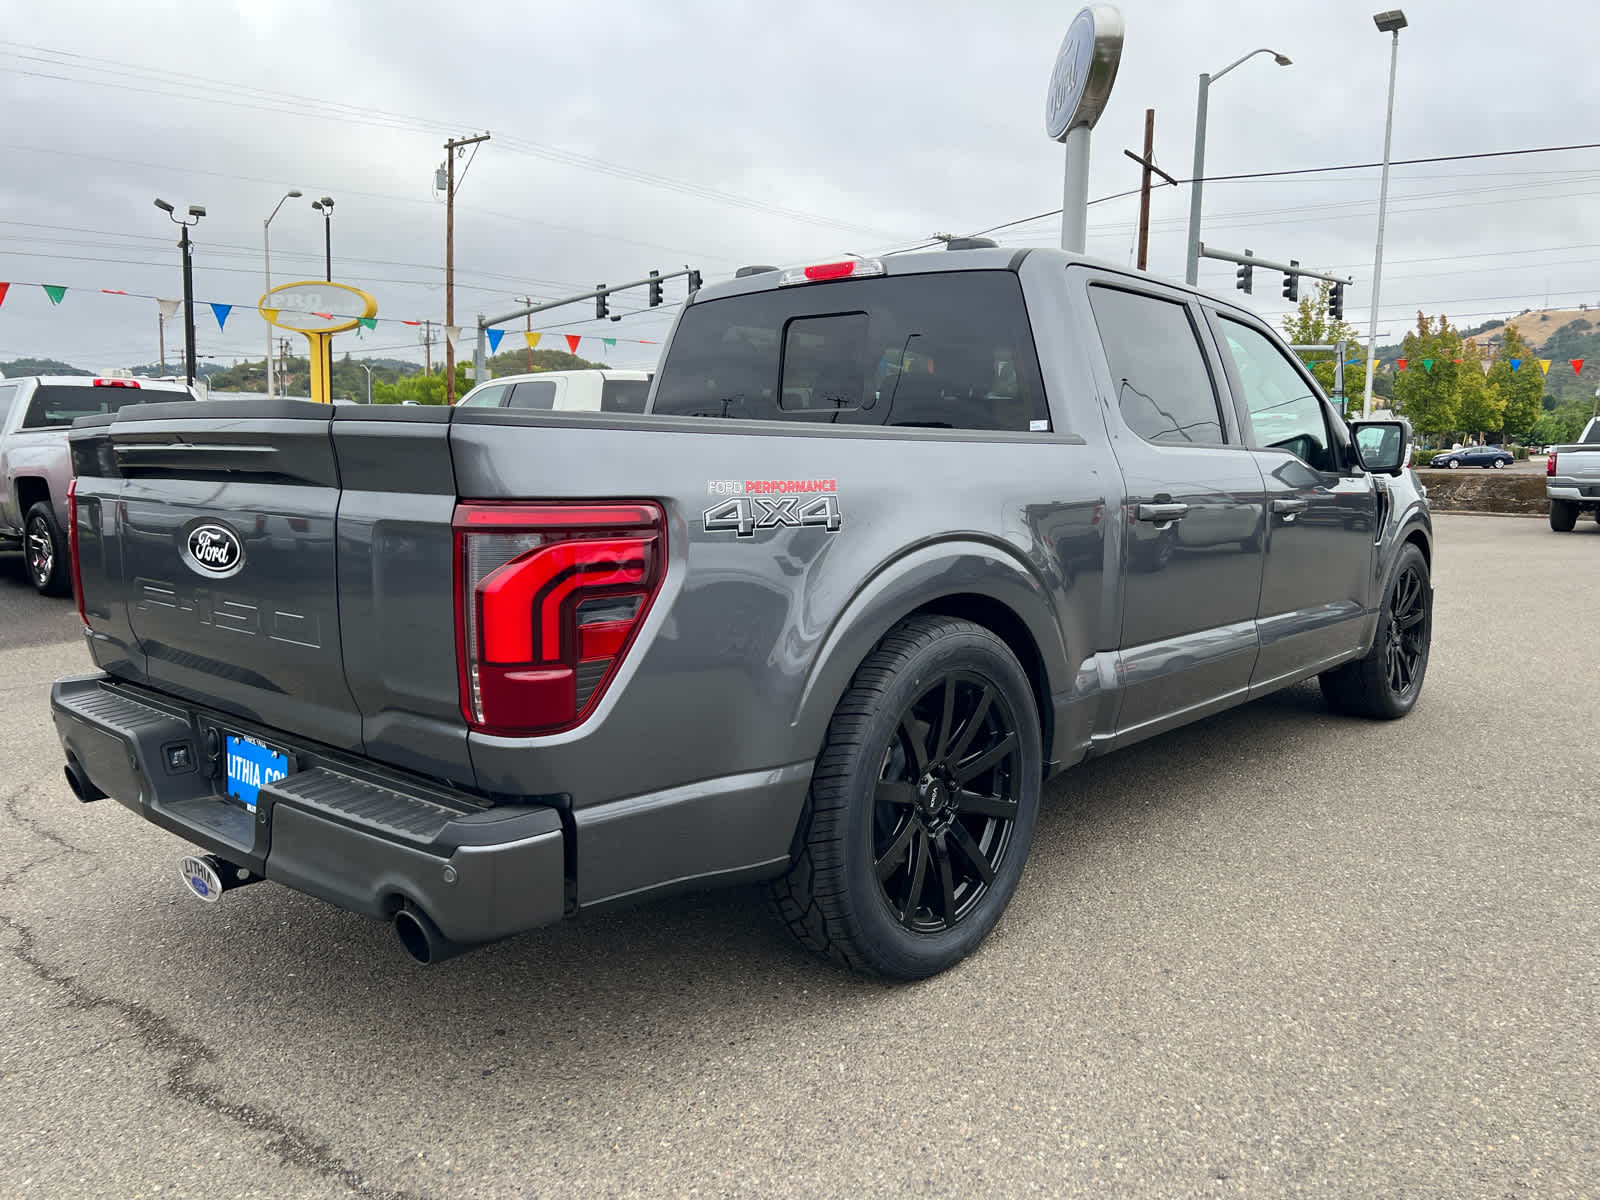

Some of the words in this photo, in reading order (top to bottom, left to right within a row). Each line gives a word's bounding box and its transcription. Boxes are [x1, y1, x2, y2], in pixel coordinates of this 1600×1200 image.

[708, 480, 742, 494] FORD
[745, 479, 836, 494] PERFORMANCE
[195, 530, 229, 563] Ford
[134, 577, 321, 649] F-150
[227, 753, 285, 790] LITHIA.C
[184, 858, 213, 888] LITHIA
